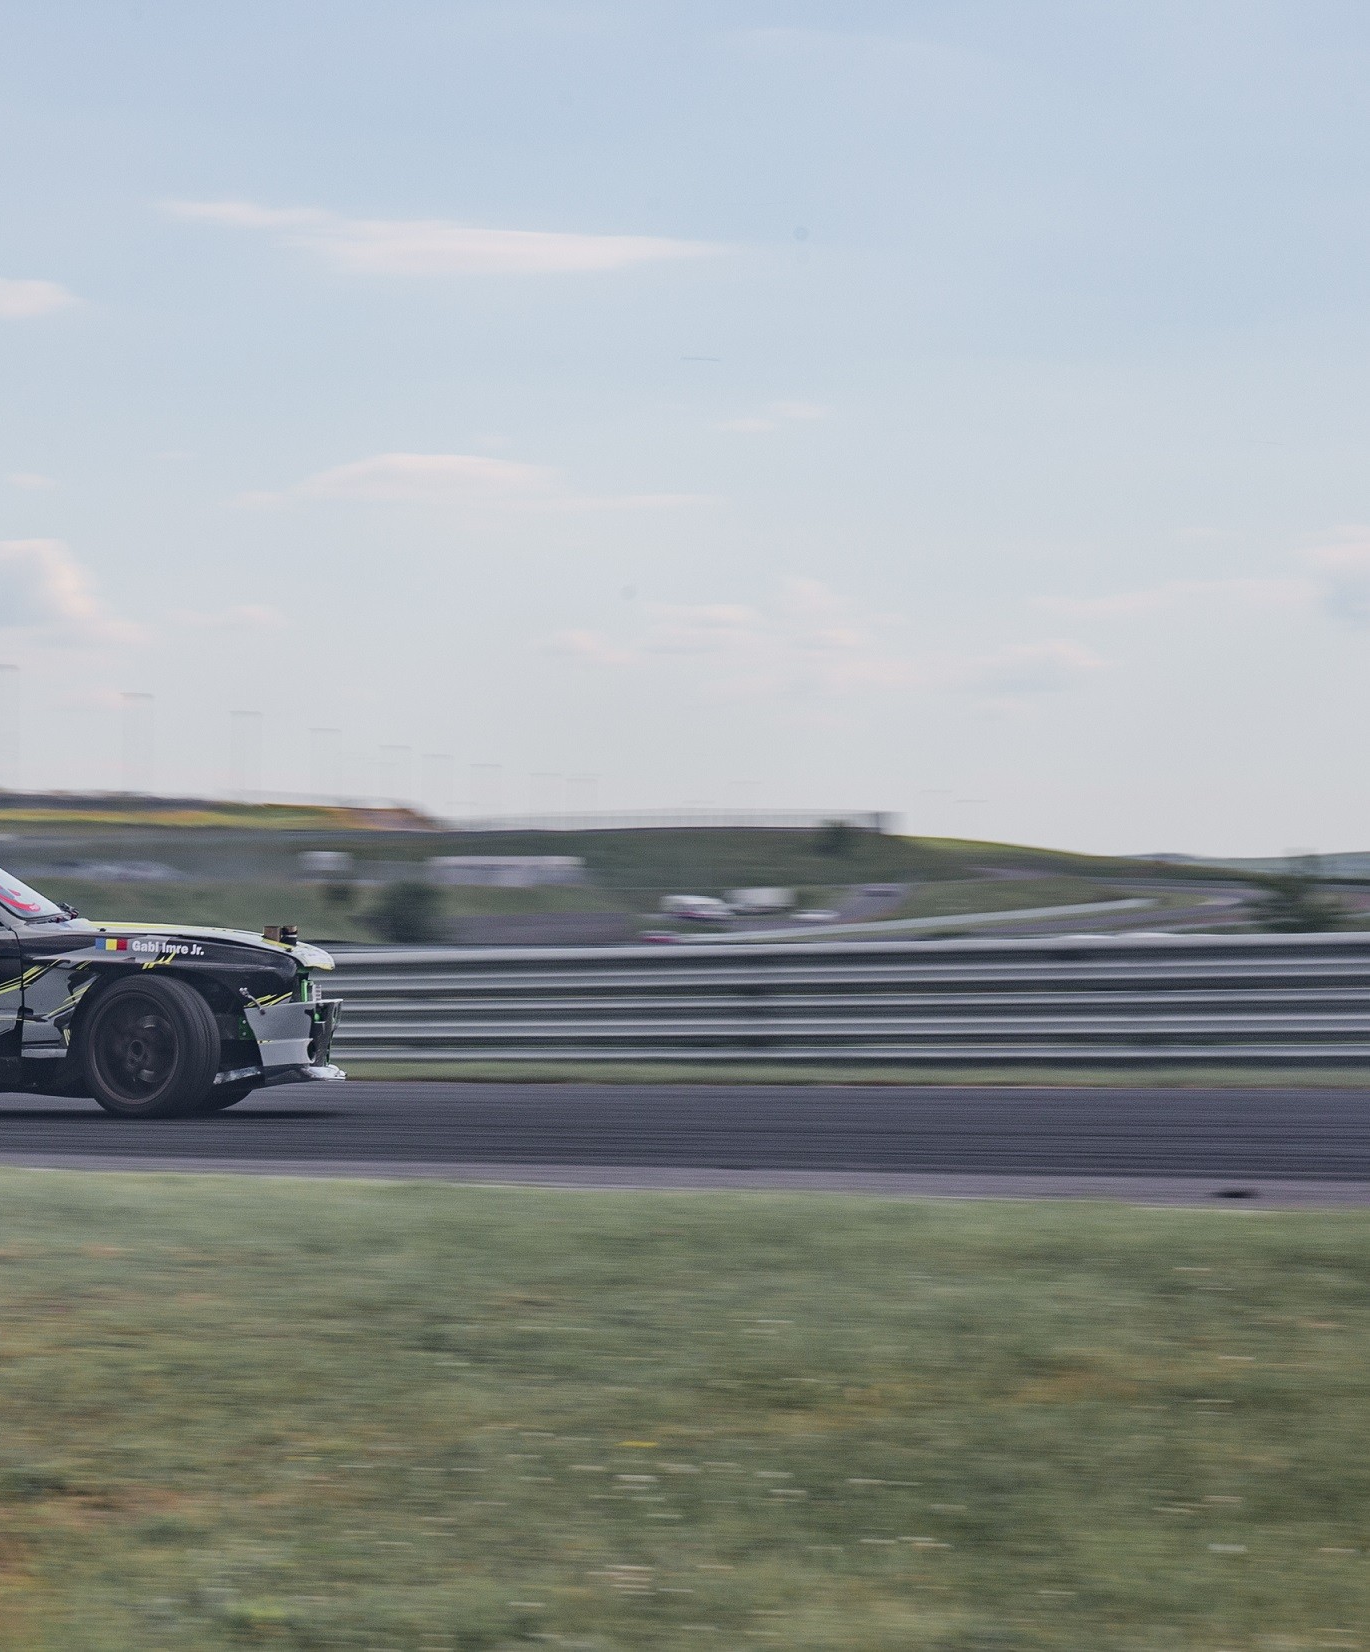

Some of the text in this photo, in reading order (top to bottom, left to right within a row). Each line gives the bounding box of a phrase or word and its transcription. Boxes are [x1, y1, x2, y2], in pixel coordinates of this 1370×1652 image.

[132, 940, 205, 956] Gabi Imre Jr.
